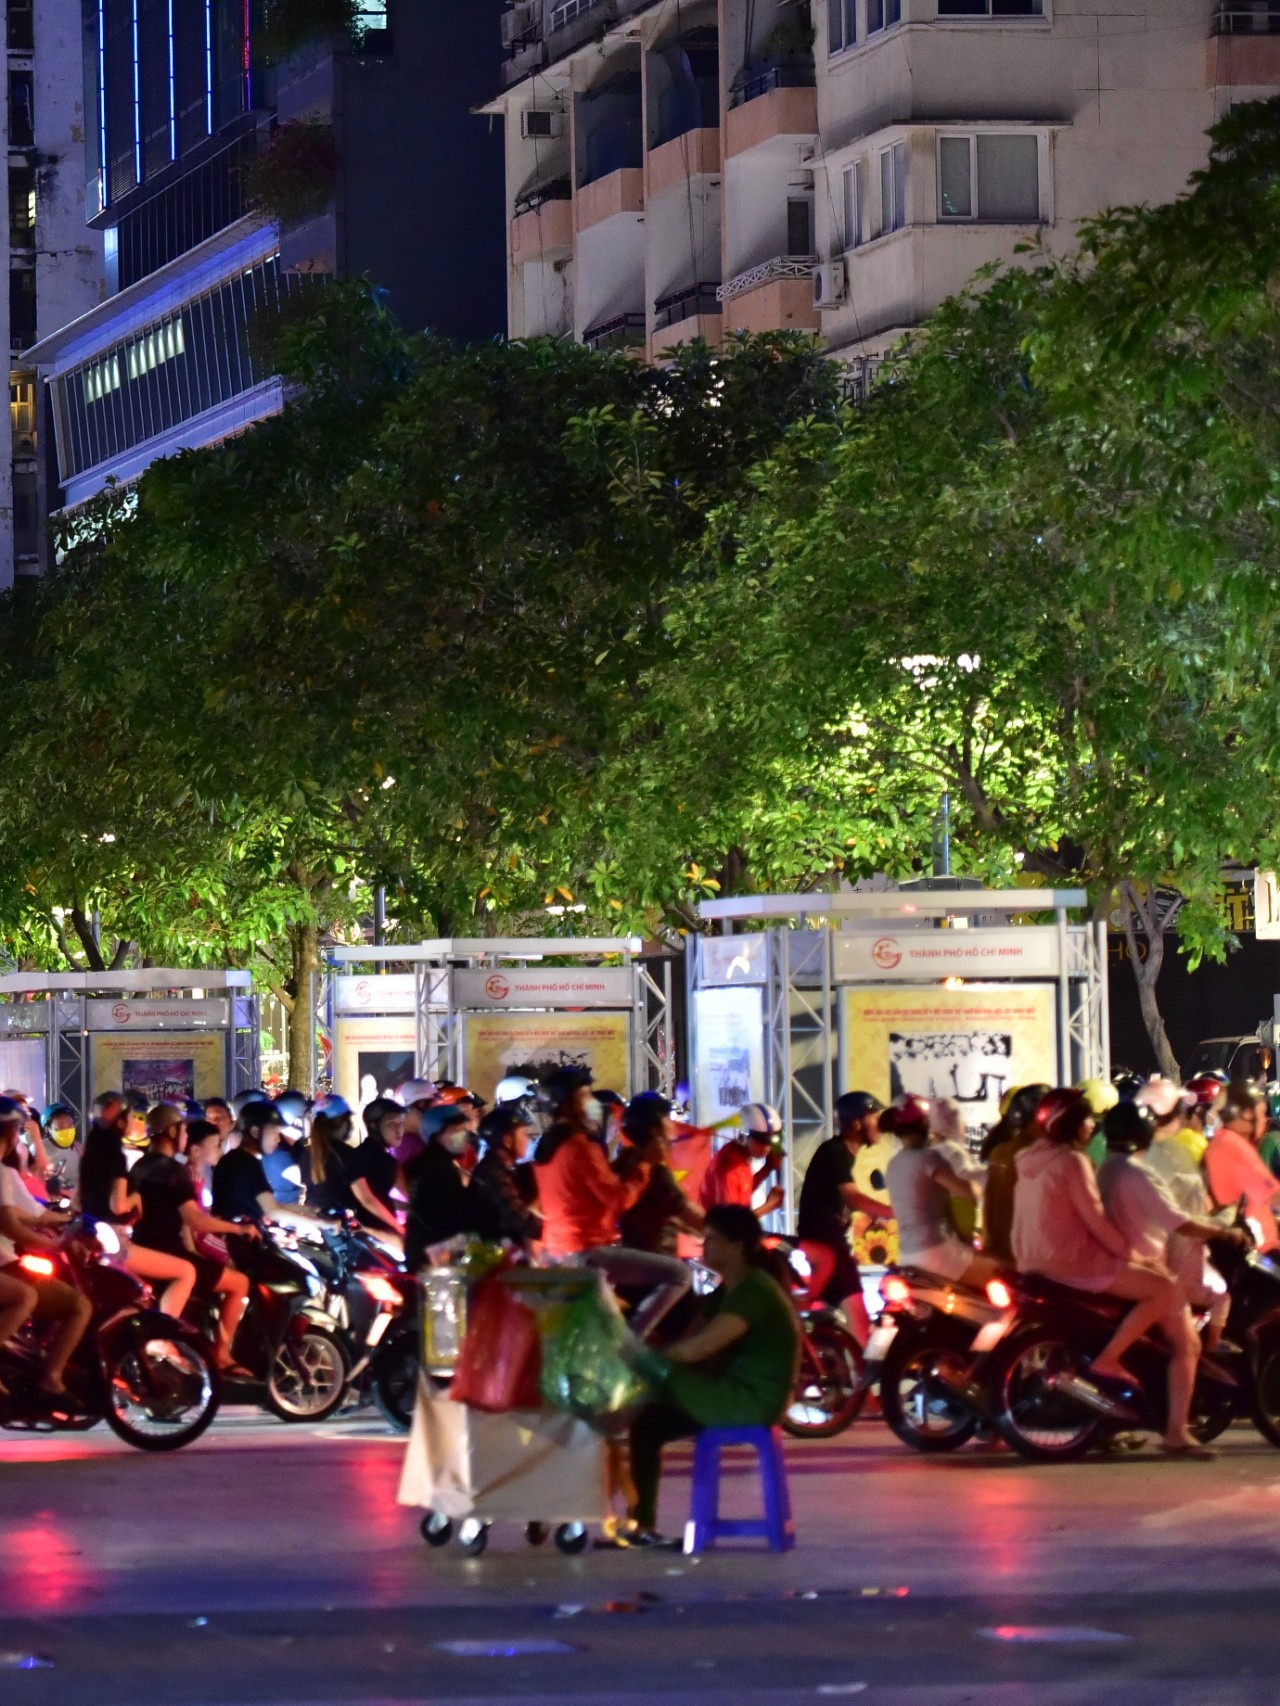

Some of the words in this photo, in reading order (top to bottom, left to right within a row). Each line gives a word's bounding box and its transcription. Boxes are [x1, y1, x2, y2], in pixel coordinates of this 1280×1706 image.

[909, 947, 941, 958] THÀNH
[999, 947, 1023, 956] MINH
[515, 983, 540, 991] THÀNH
[586, 983, 605, 991] MINH
